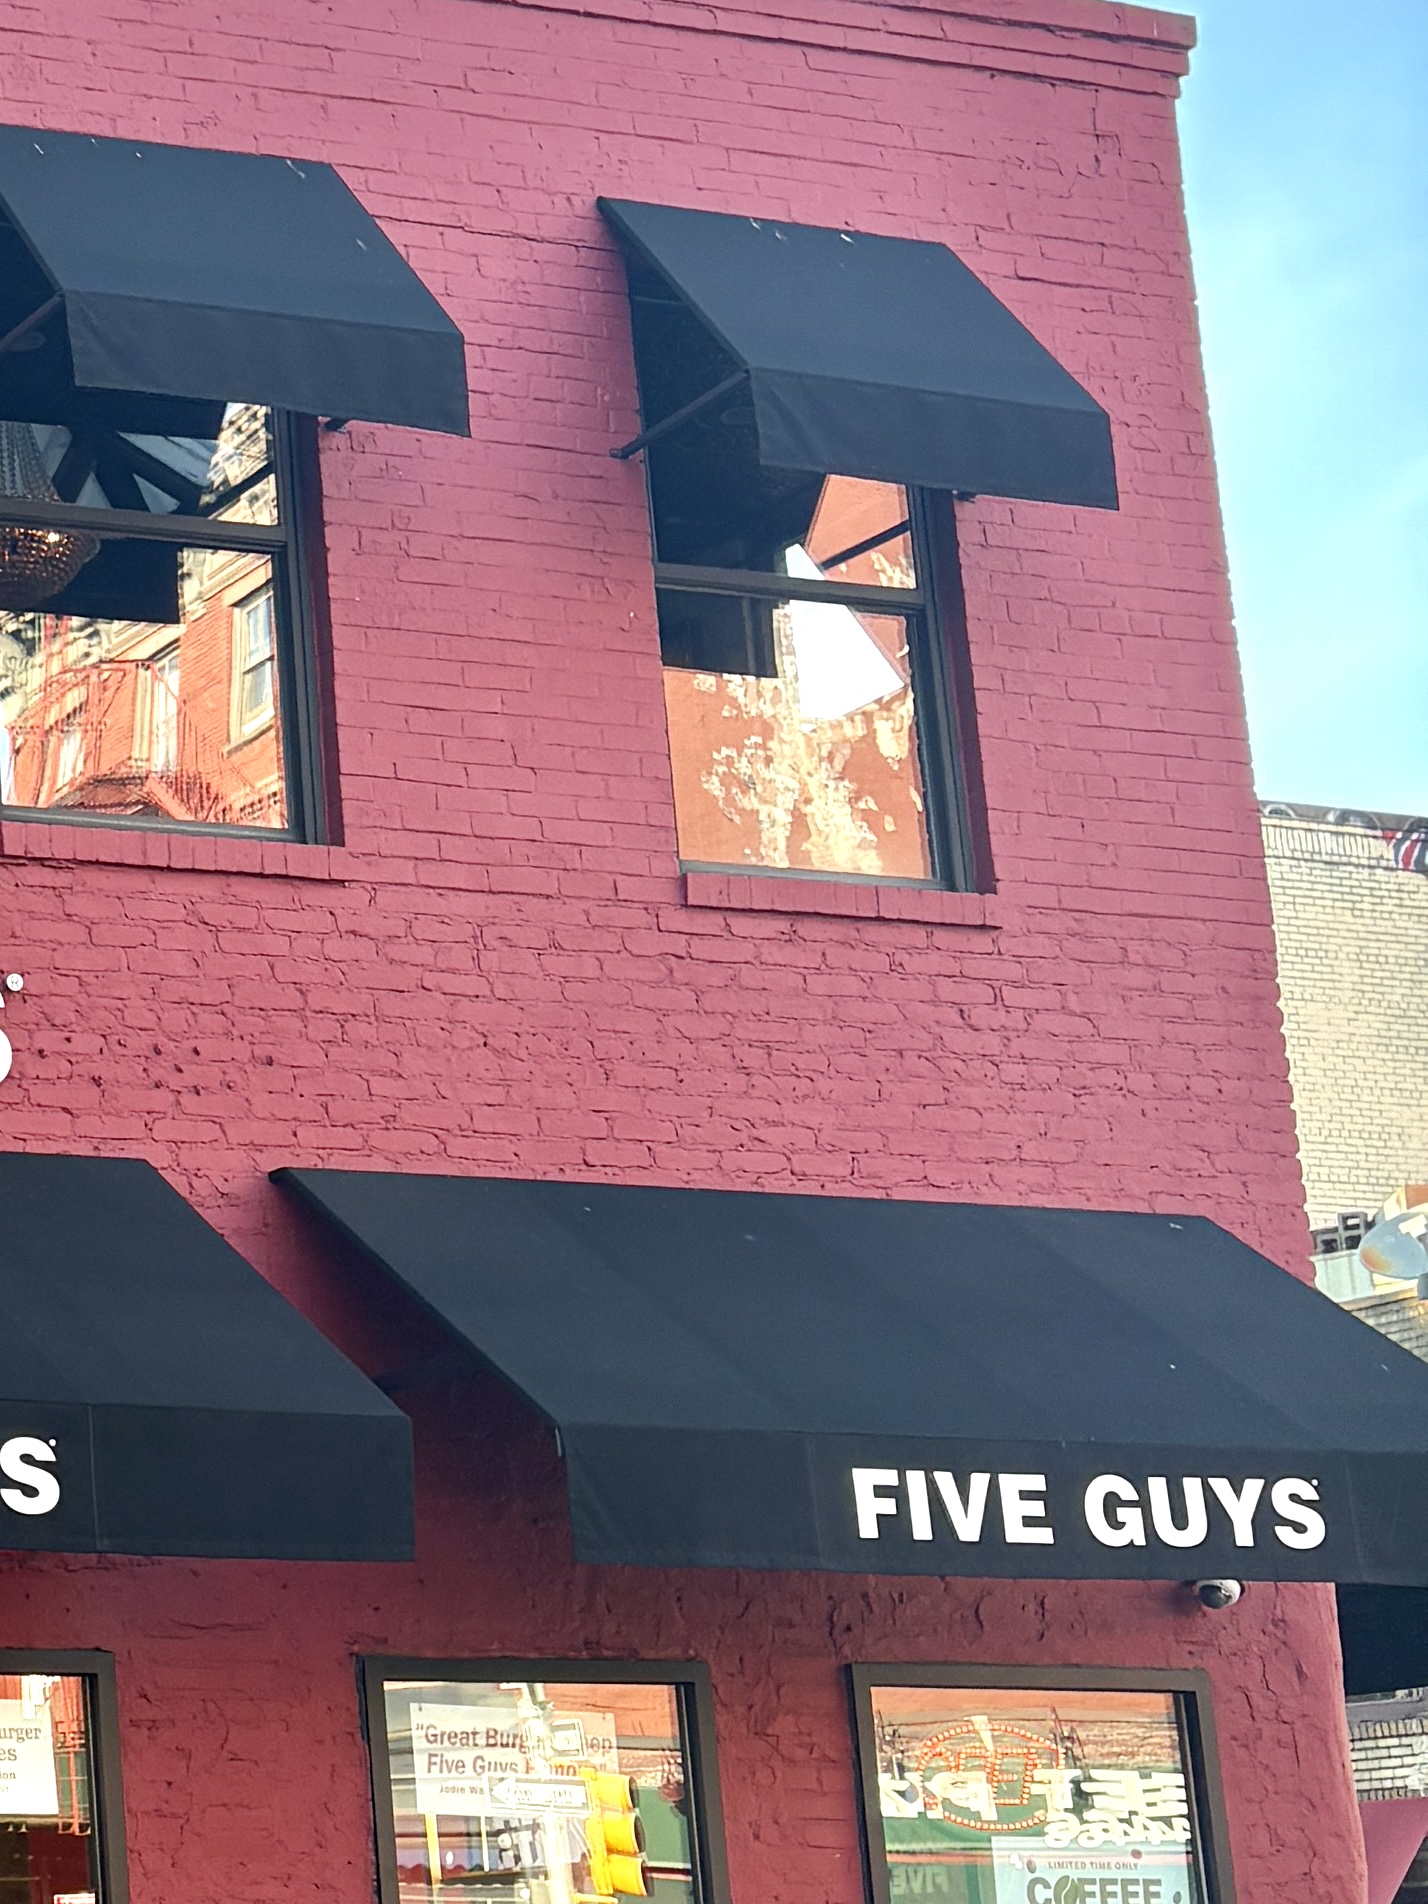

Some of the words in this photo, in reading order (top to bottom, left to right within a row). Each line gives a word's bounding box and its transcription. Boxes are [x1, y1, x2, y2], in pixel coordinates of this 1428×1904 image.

[851, 1467, 1055, 1545] FIVE
[1083, 1473, 1327, 1551] GUYS
[485, 1727, 536, 1755] Burg
[426, 1753, 466, 1775] Five
[472, 1755, 519, 1777] Guys
[1048, 1860, 1086, 1870] LIMITED
[1090, 1861, 1112, 1870] TIME
[1114, 1861, 1139, 1871] ONLY
